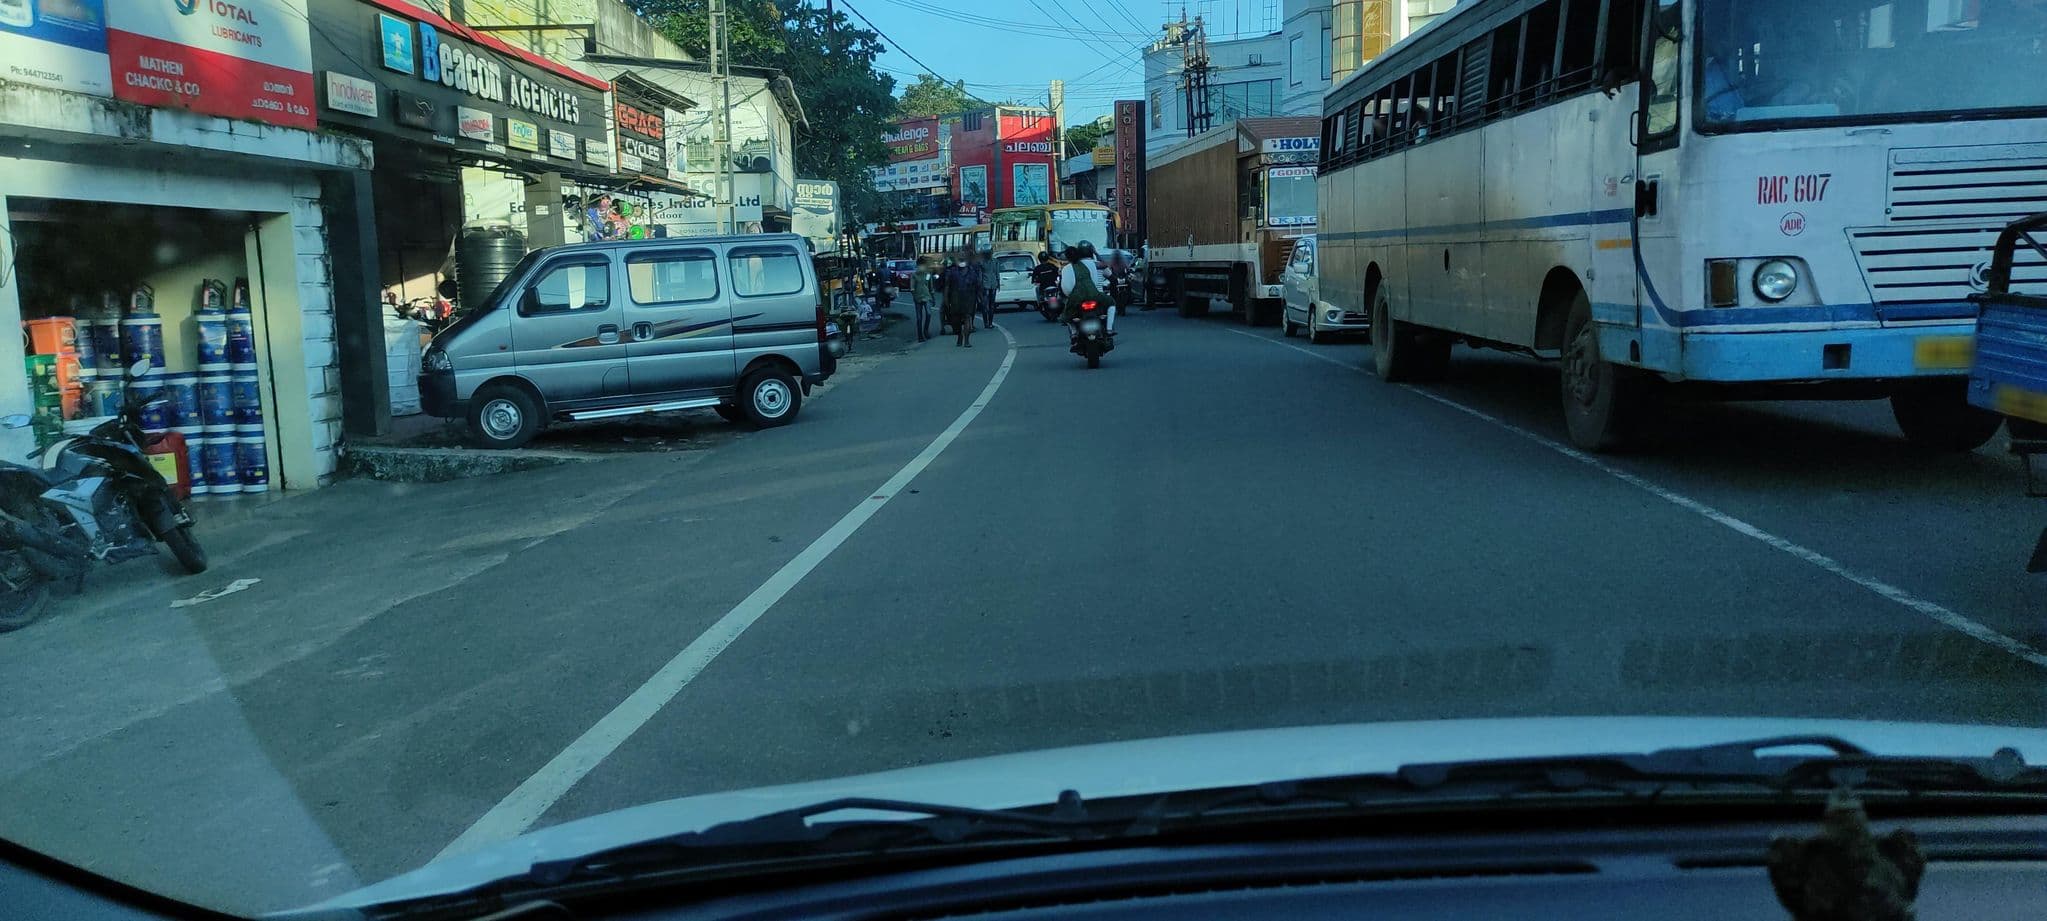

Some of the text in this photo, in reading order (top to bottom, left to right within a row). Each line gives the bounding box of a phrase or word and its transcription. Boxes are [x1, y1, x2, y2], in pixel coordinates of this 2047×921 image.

[208, 0, 258, 25] TOTAL
[211, 24, 263, 48] LUBRICANTS
[139, 55, 184, 76] MATHEN
[419, 21, 580, 124] Beacon AGENCIES
[125, 72, 173, 92] CHACKO
[174, 80, 183, 94] &
[331, 80, 374, 105] hindware
[618, 103, 664, 140] GRACE
[625, 138, 660, 162] CYCLES
[1279, 138, 1320, 150] HOLY
[1757, 173, 1832, 205] RAC 607
[669, 196, 706, 209] India
